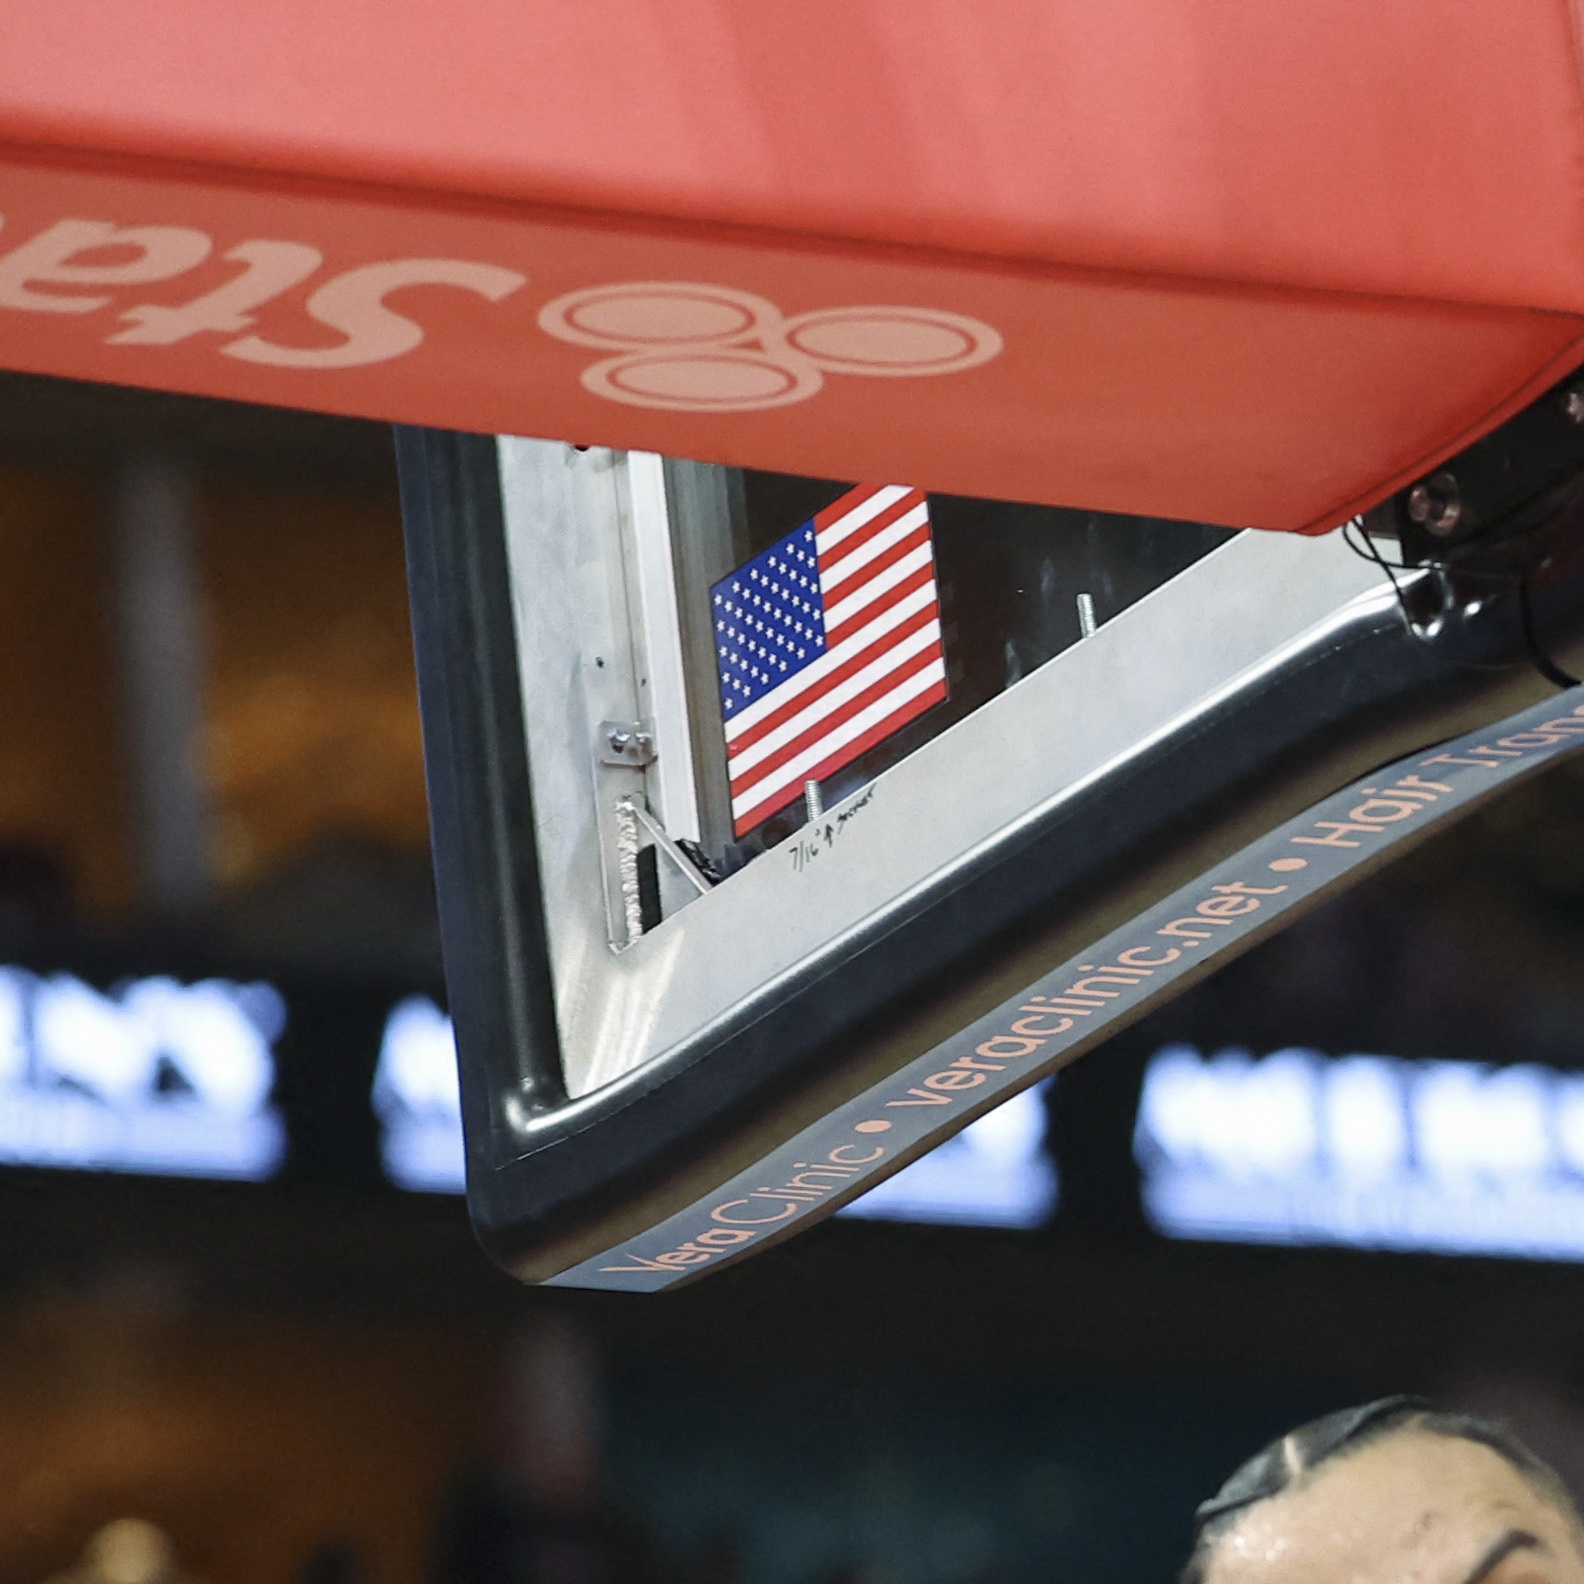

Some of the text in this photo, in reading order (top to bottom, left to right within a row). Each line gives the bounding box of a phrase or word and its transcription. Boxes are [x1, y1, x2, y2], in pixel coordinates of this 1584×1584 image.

[0, 217, 528, 369] Sta
[887, 881, 1289, 1107] veraclinic.net
[1291, 774, 1453, 848] Hair
